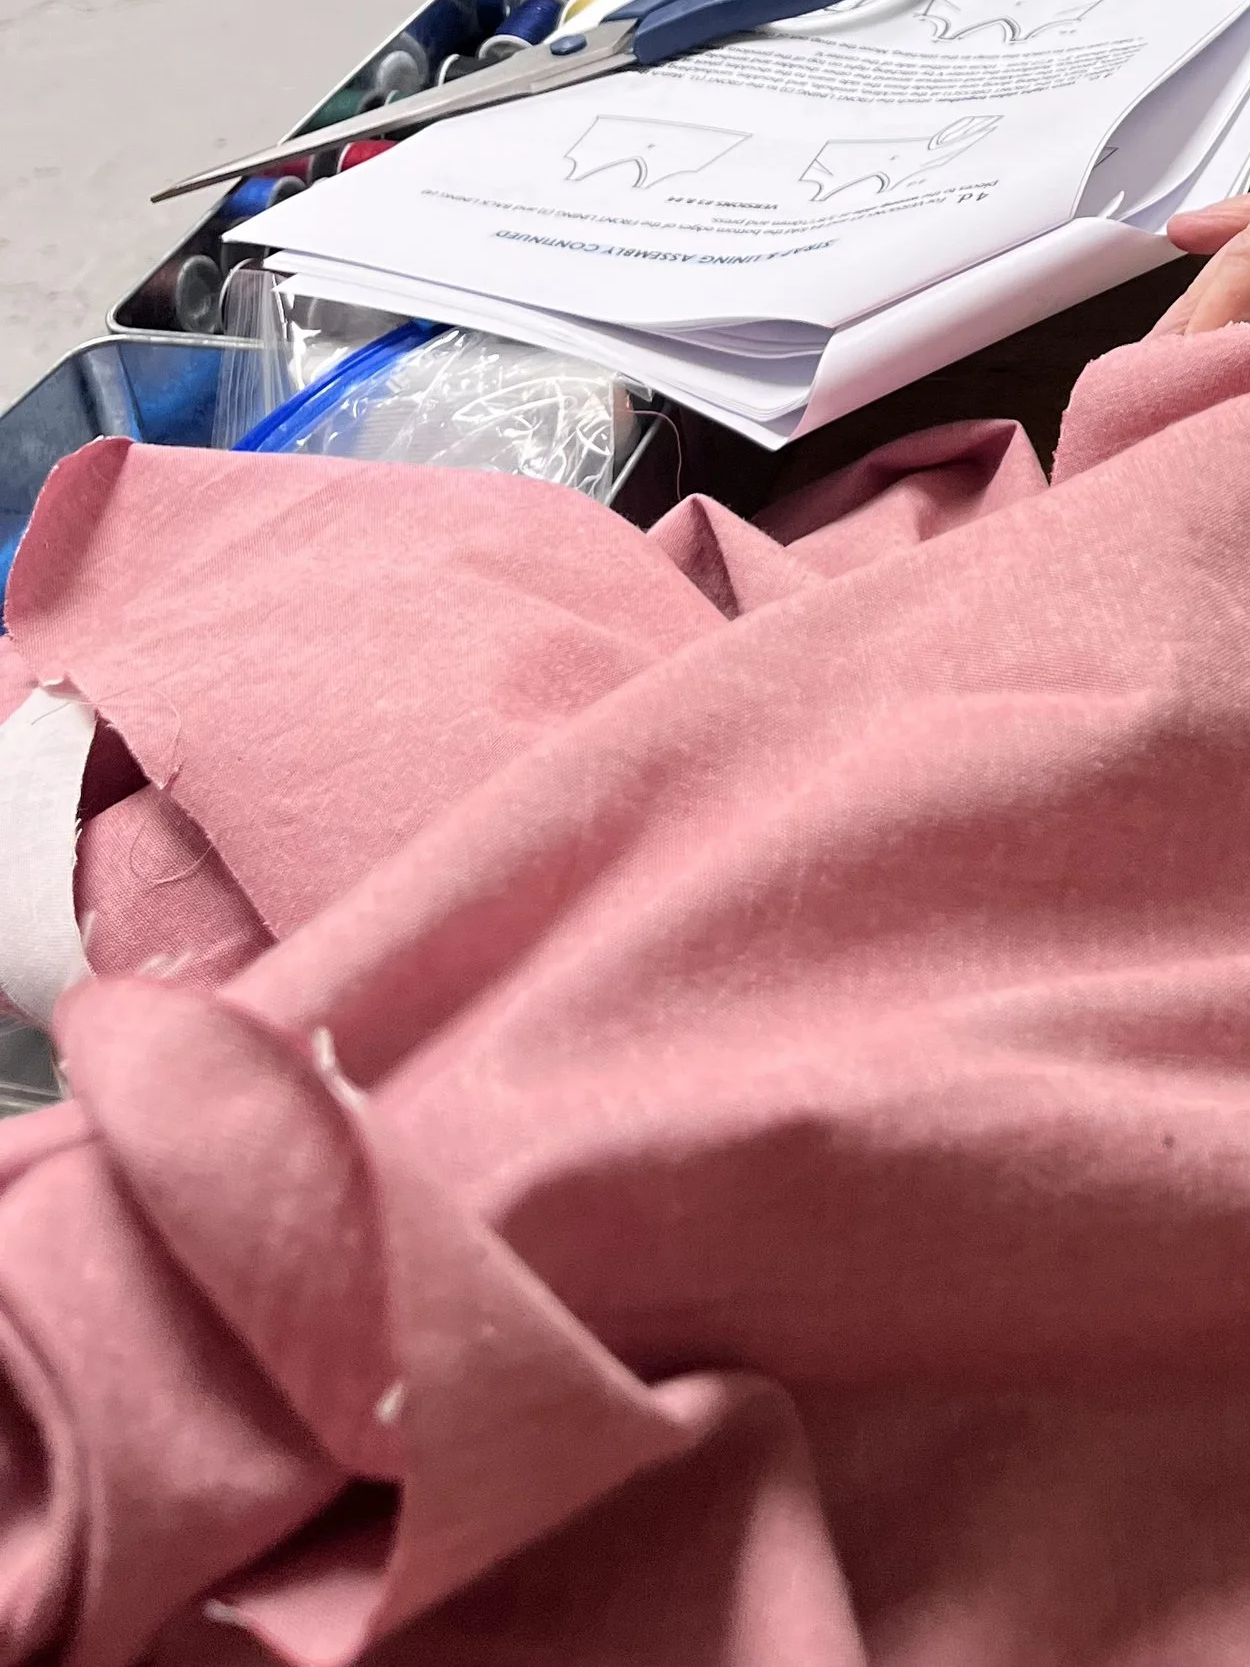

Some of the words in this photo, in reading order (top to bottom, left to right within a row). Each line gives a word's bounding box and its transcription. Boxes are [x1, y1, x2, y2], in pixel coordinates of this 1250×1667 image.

[976, 192, 989, 202] 4
[512, 205, 538, 213] and
[553, 210, 598, 222] LINING
[596, 216, 640, 227] FRONT
[640, 221, 661, 230] the
[716, 227, 762, 236] bottom
[494, 230, 600, 252] CONTINUED
[781, 239, 836, 258] STRAP
[601, 246, 697, 263] ASSEMBLY
[698, 255, 762, 265] LINING
